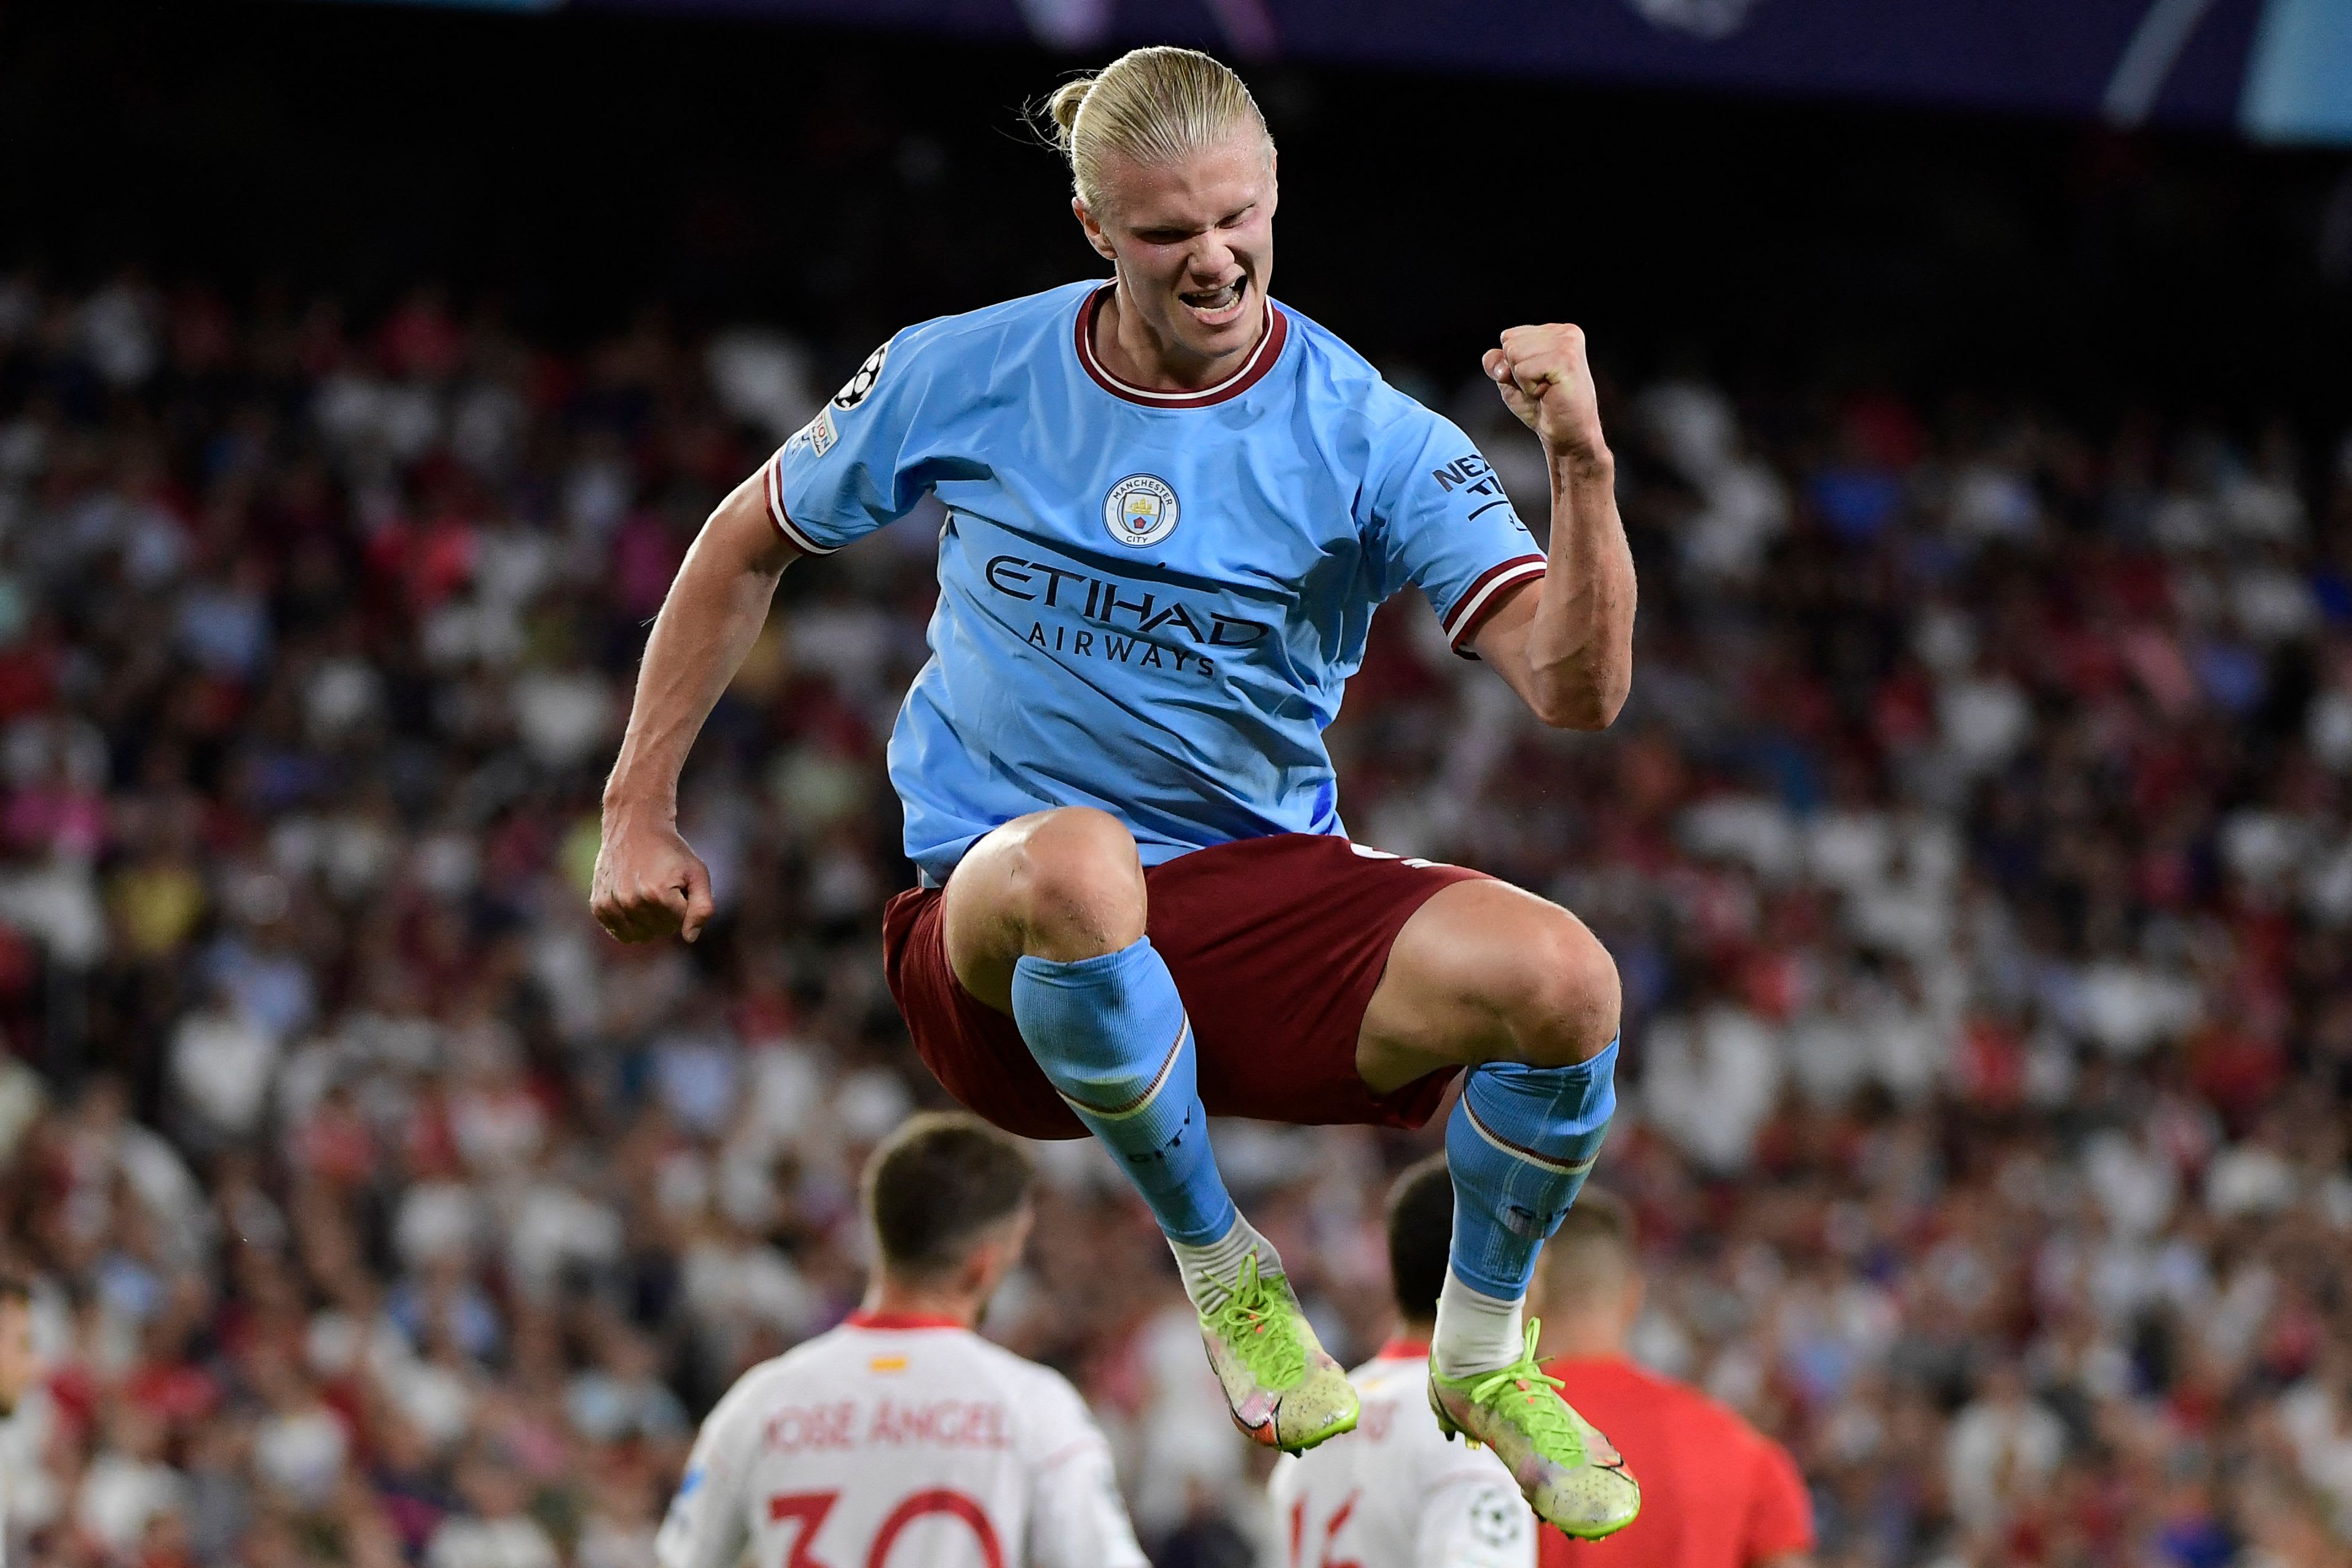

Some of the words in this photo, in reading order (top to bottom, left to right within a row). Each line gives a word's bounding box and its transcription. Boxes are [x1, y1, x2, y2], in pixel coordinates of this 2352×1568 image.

[1113, 480, 1173, 505] MANCHESTER
[985, 555, 1269, 648] ETIHAD
[1029, 621, 1214, 676] AIRWAYS
